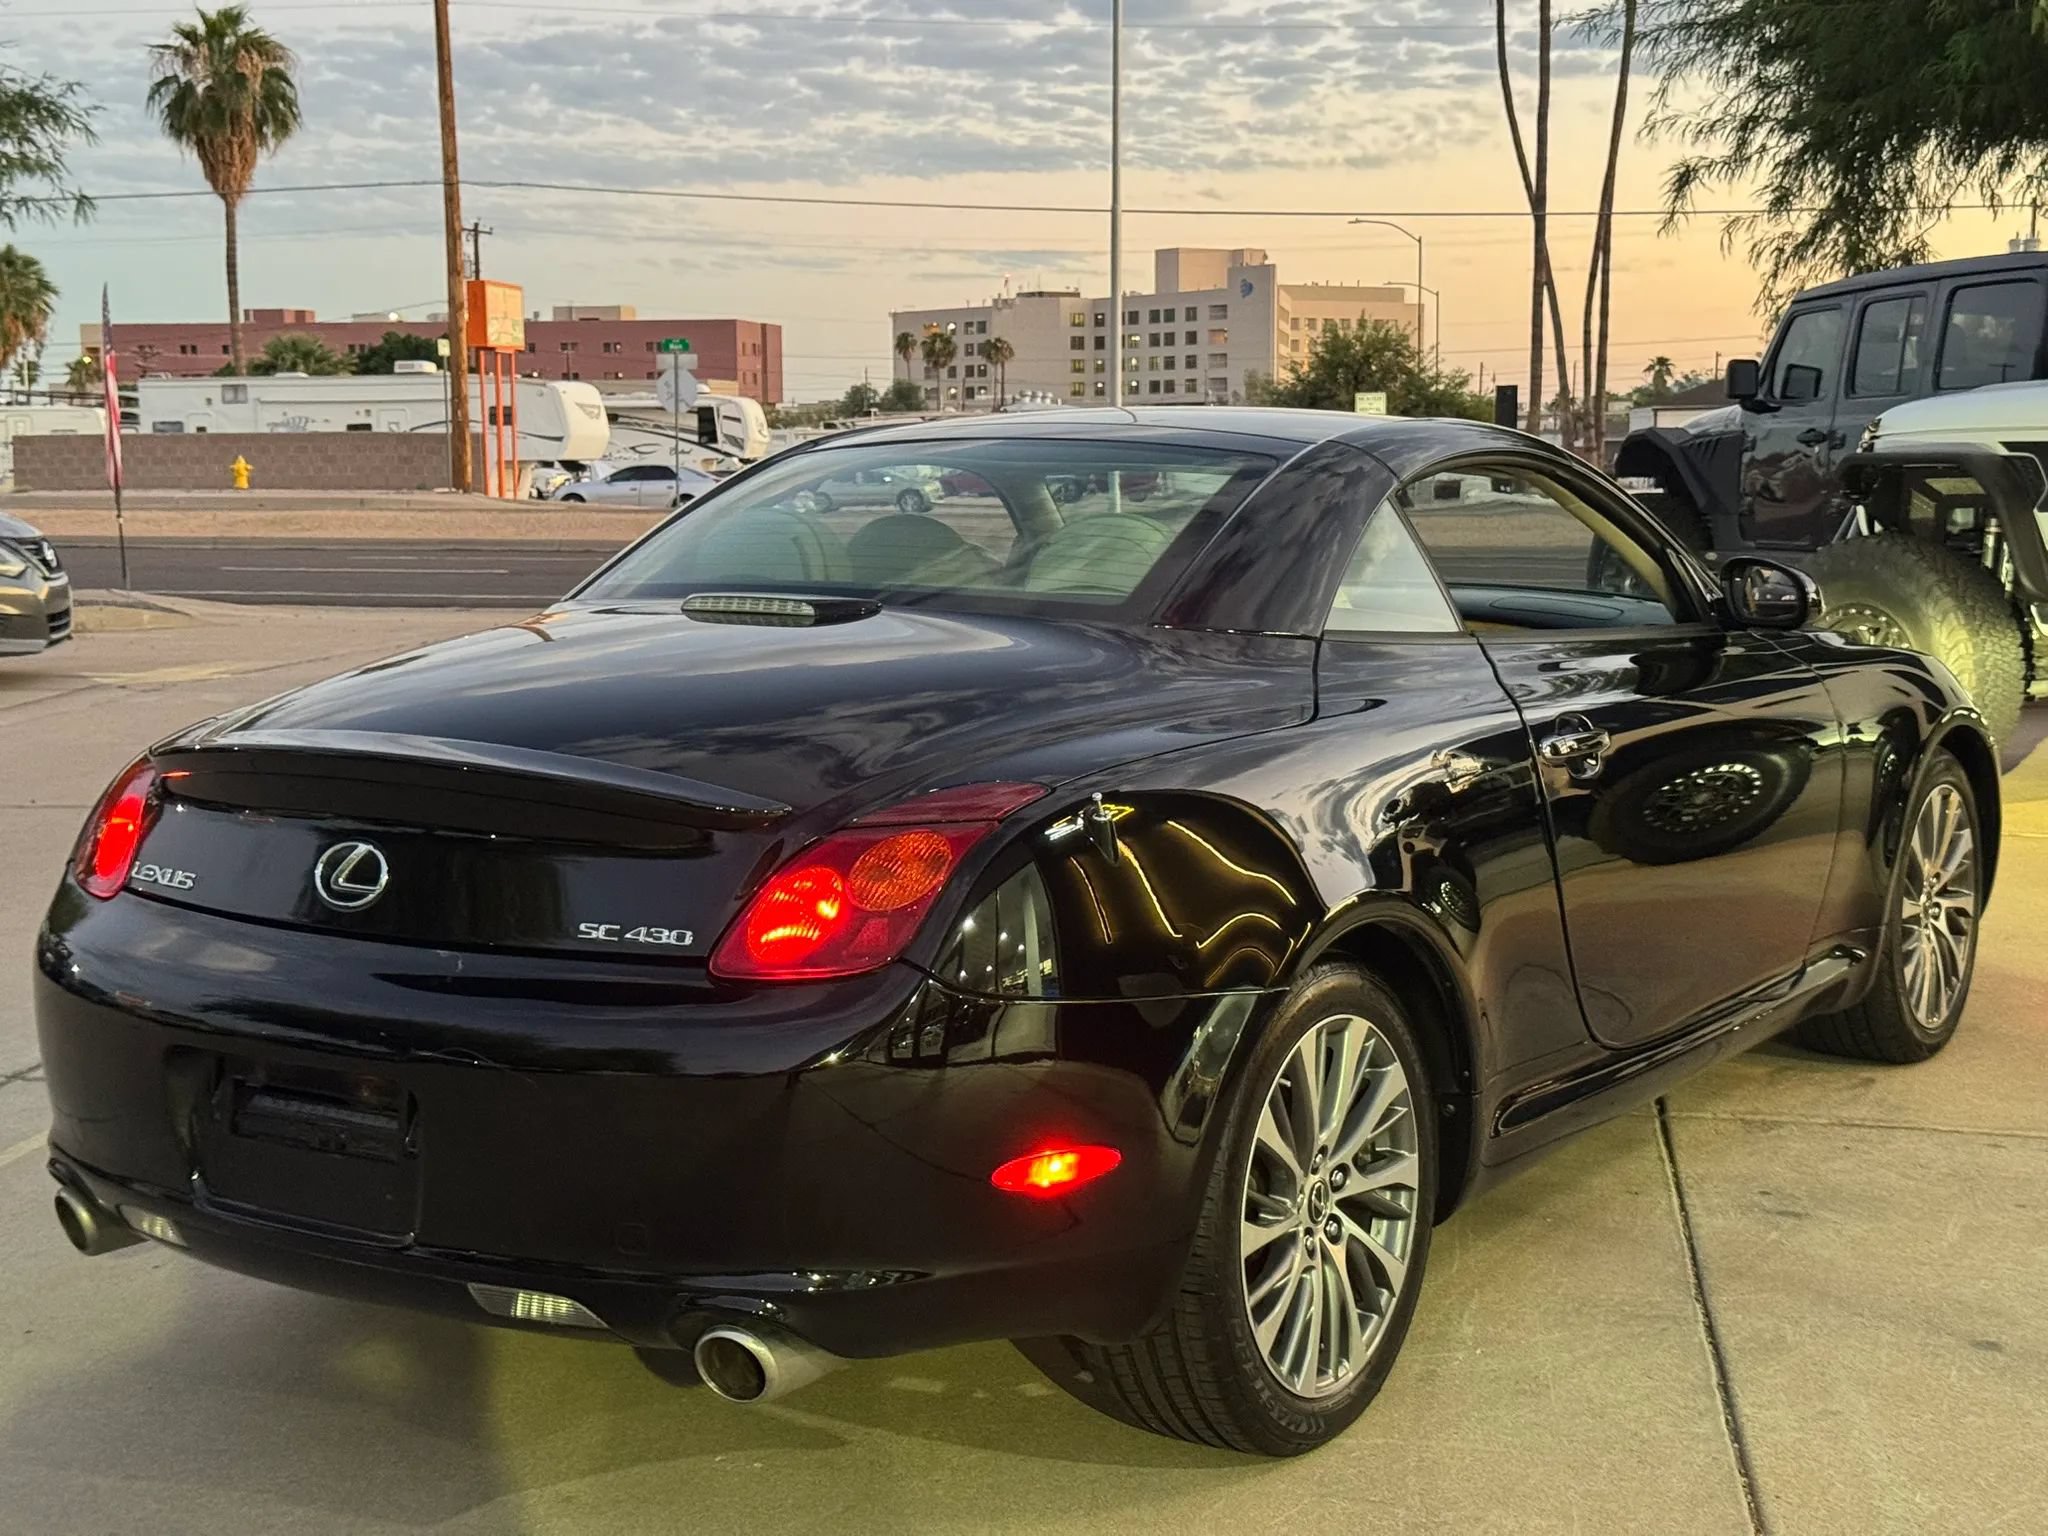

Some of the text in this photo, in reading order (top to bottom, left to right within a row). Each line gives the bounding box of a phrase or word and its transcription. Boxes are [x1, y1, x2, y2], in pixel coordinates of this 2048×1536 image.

[131, 861, 196, 889] LEXUS
[577, 922, 693, 945] SC 430
